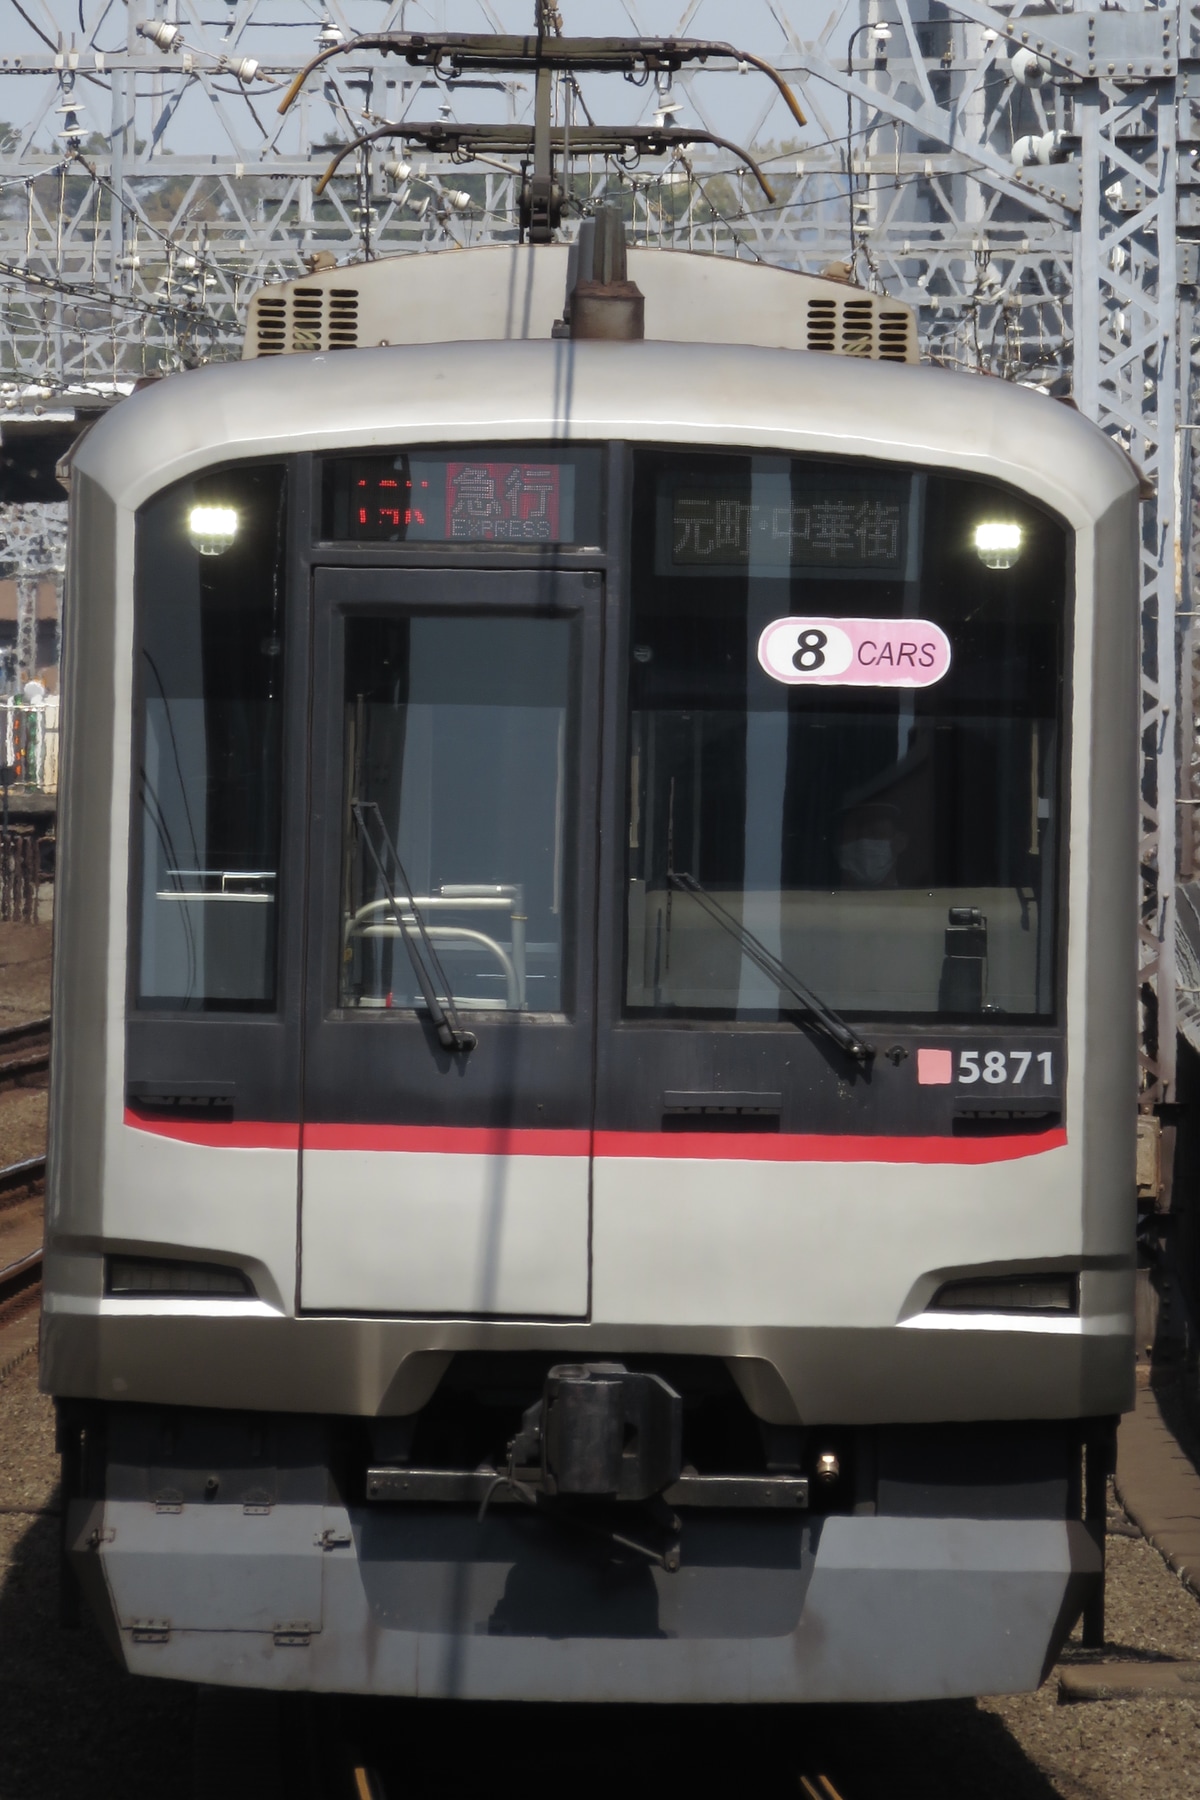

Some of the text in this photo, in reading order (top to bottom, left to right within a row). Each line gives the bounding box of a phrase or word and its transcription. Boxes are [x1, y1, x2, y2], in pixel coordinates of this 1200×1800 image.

[452, 467, 554, 517] 急行
[452, 518, 551, 537] EXPRESS
[791, 628, 936, 672] 8 CARS
[958, 1051, 1053, 1085] 5871
